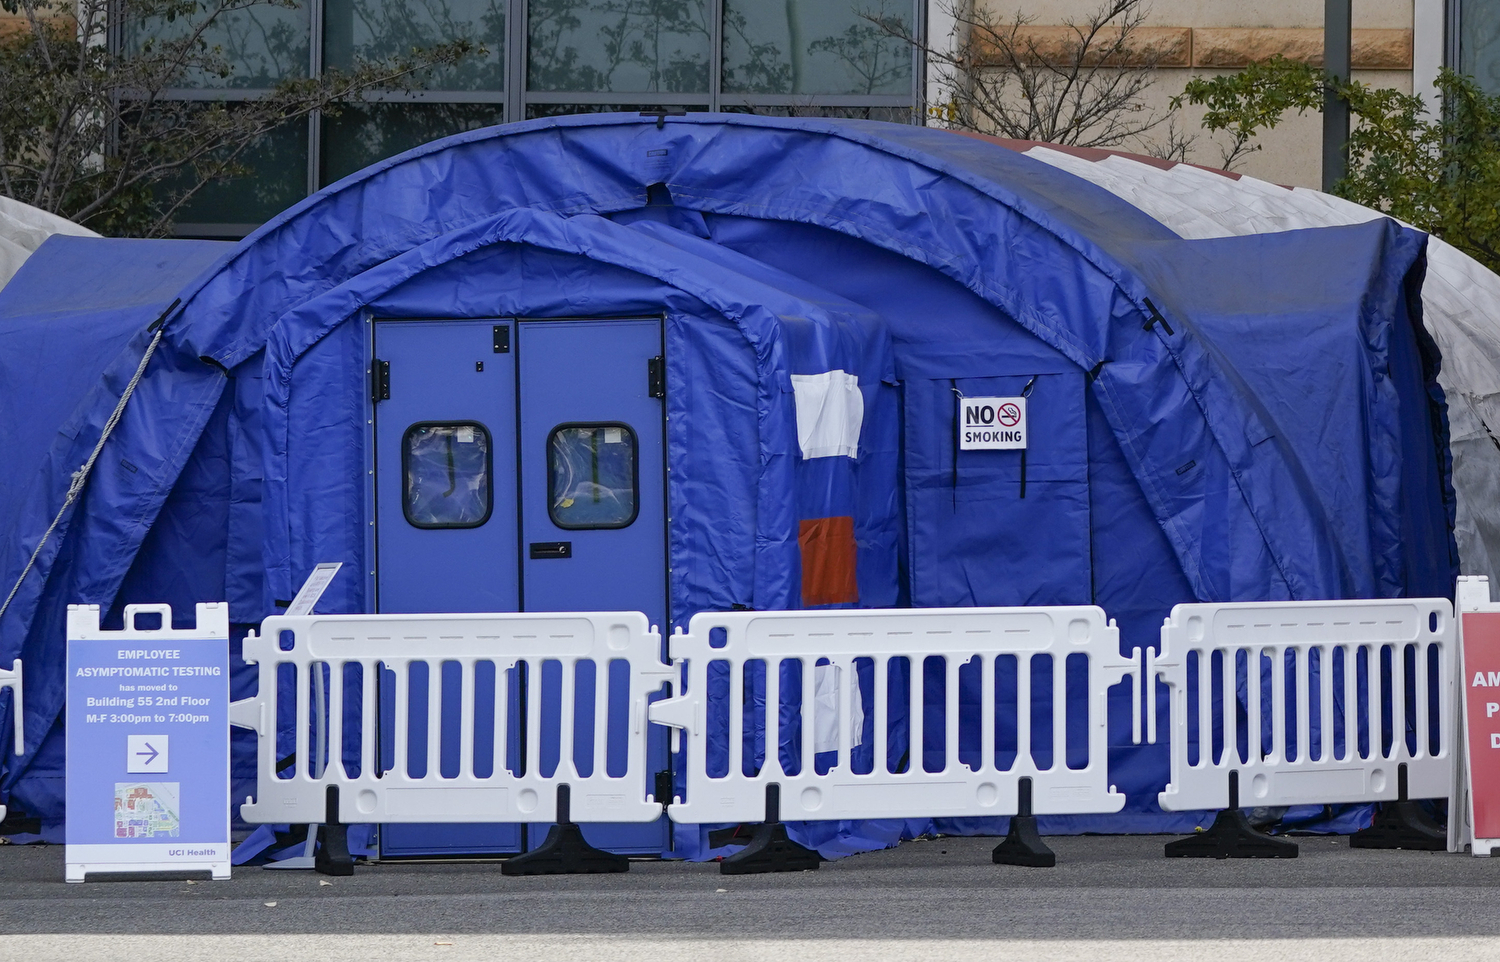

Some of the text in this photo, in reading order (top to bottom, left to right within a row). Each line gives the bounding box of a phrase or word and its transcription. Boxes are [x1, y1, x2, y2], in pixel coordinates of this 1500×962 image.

[966, 405, 995, 424] NO
[965, 431, 1022, 443] SMOKING
[117, 649, 181, 660] EMPLOYEE
[76, 667, 221, 677] ASYMPTOMATIC TESTING
[119, 684, 178, 692] has moved to
[86, 696, 211, 709] Building 55 2nd Floor
[86, 713, 210, 725] M-F 3:00pm to 7:00pm
[168, 849, 185, 857] UCI
